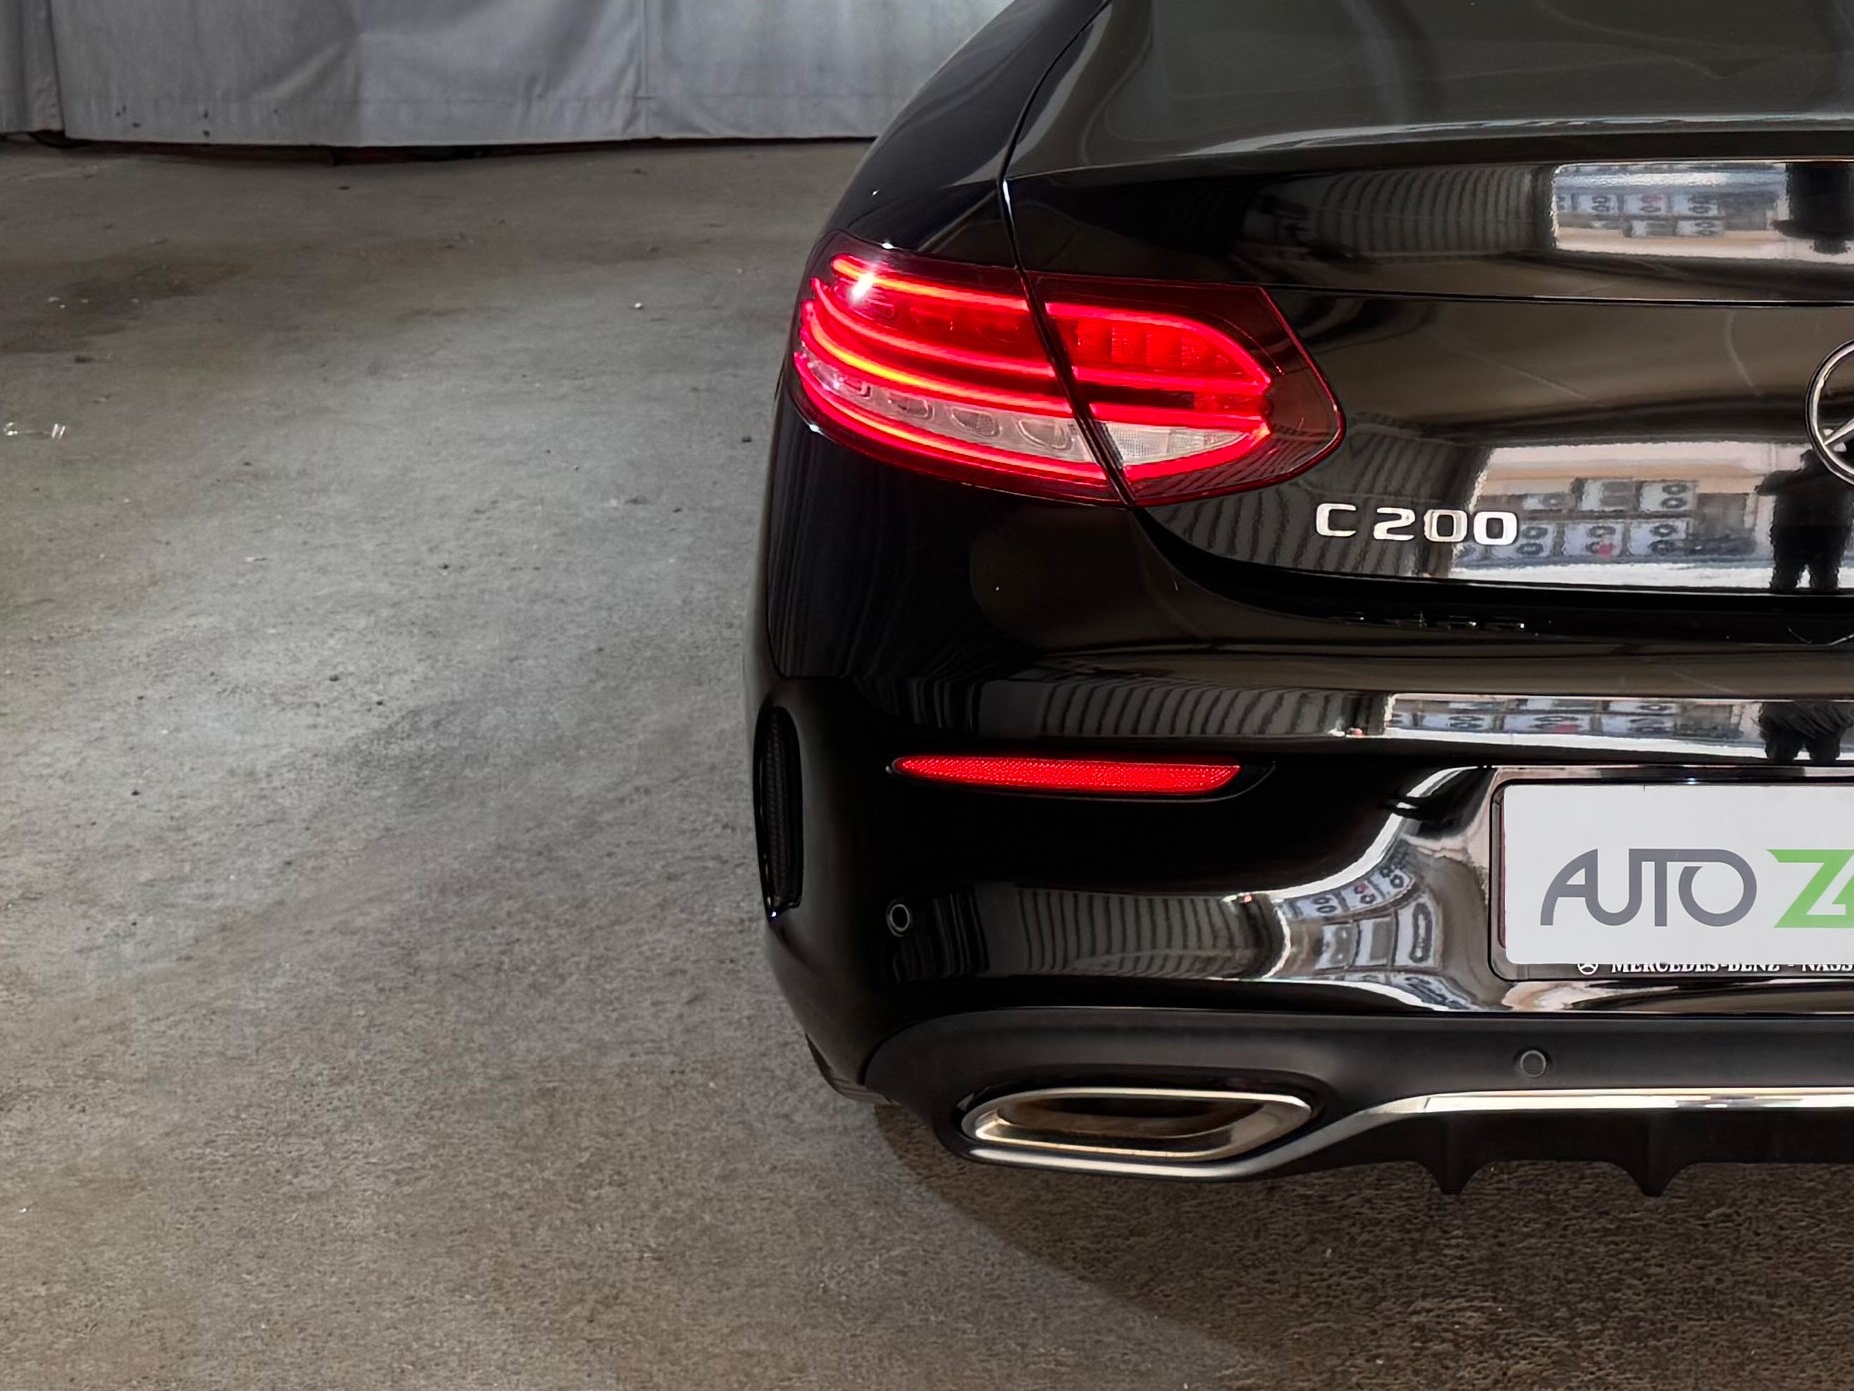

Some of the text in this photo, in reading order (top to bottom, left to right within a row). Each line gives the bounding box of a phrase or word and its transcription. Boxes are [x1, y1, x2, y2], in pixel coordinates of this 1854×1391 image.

[1316, 503, 1518, 546] C 200
[1540, 849, 1757, 927] AUTO
